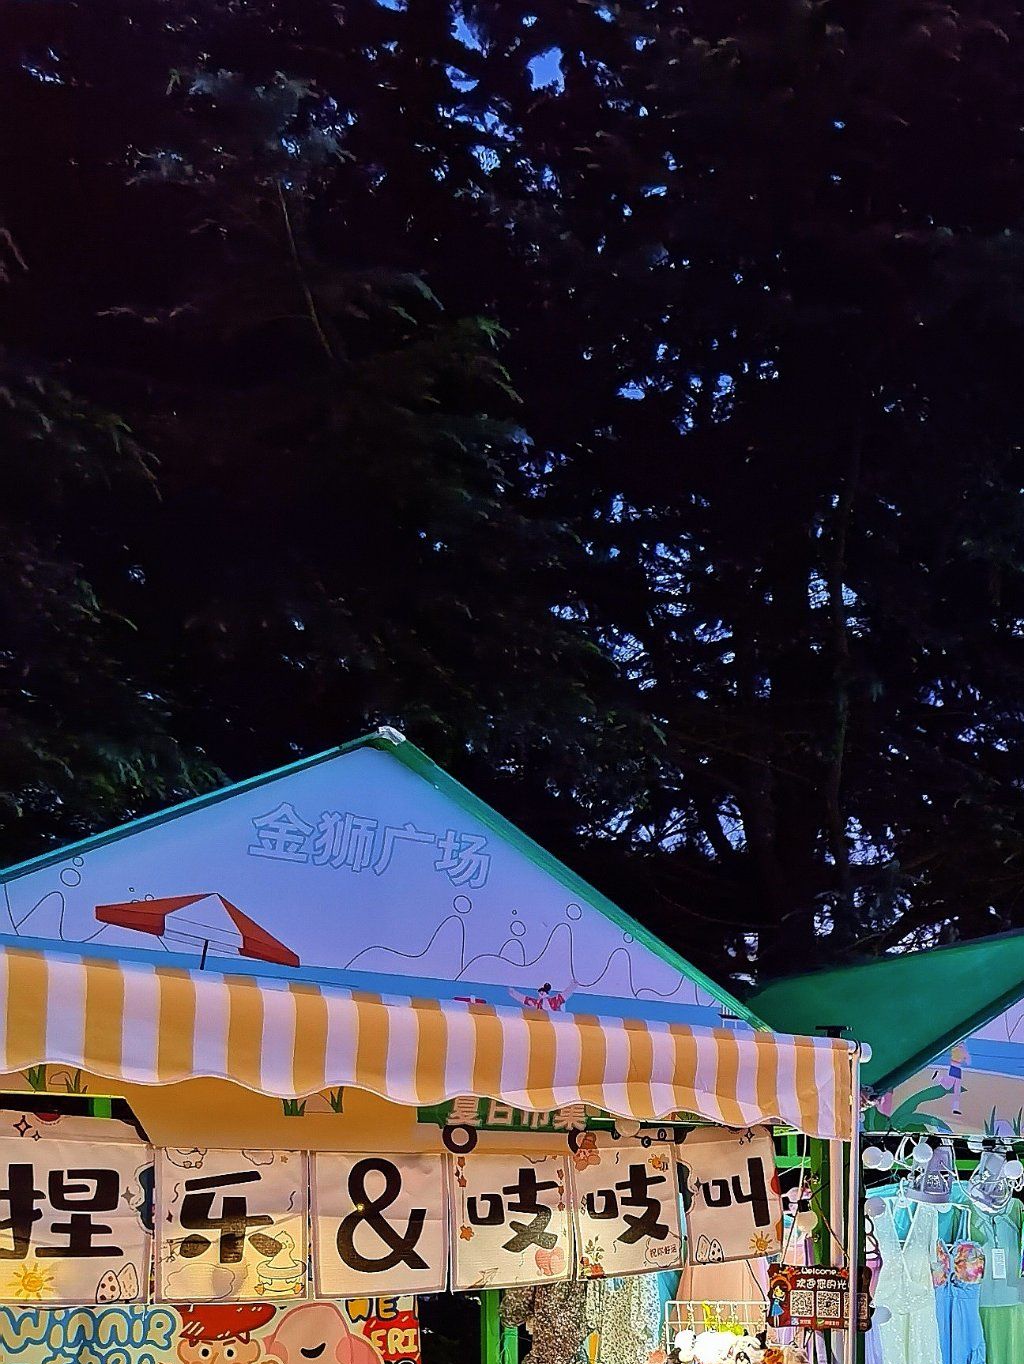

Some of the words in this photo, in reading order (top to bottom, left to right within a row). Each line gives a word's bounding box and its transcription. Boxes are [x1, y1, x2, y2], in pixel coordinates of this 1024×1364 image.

[247, 801, 491, 890] 金狮广场
[801, 1267, 837, 1276] Welcome
[796, 1278, 849, 1290] 欢迎您的光
